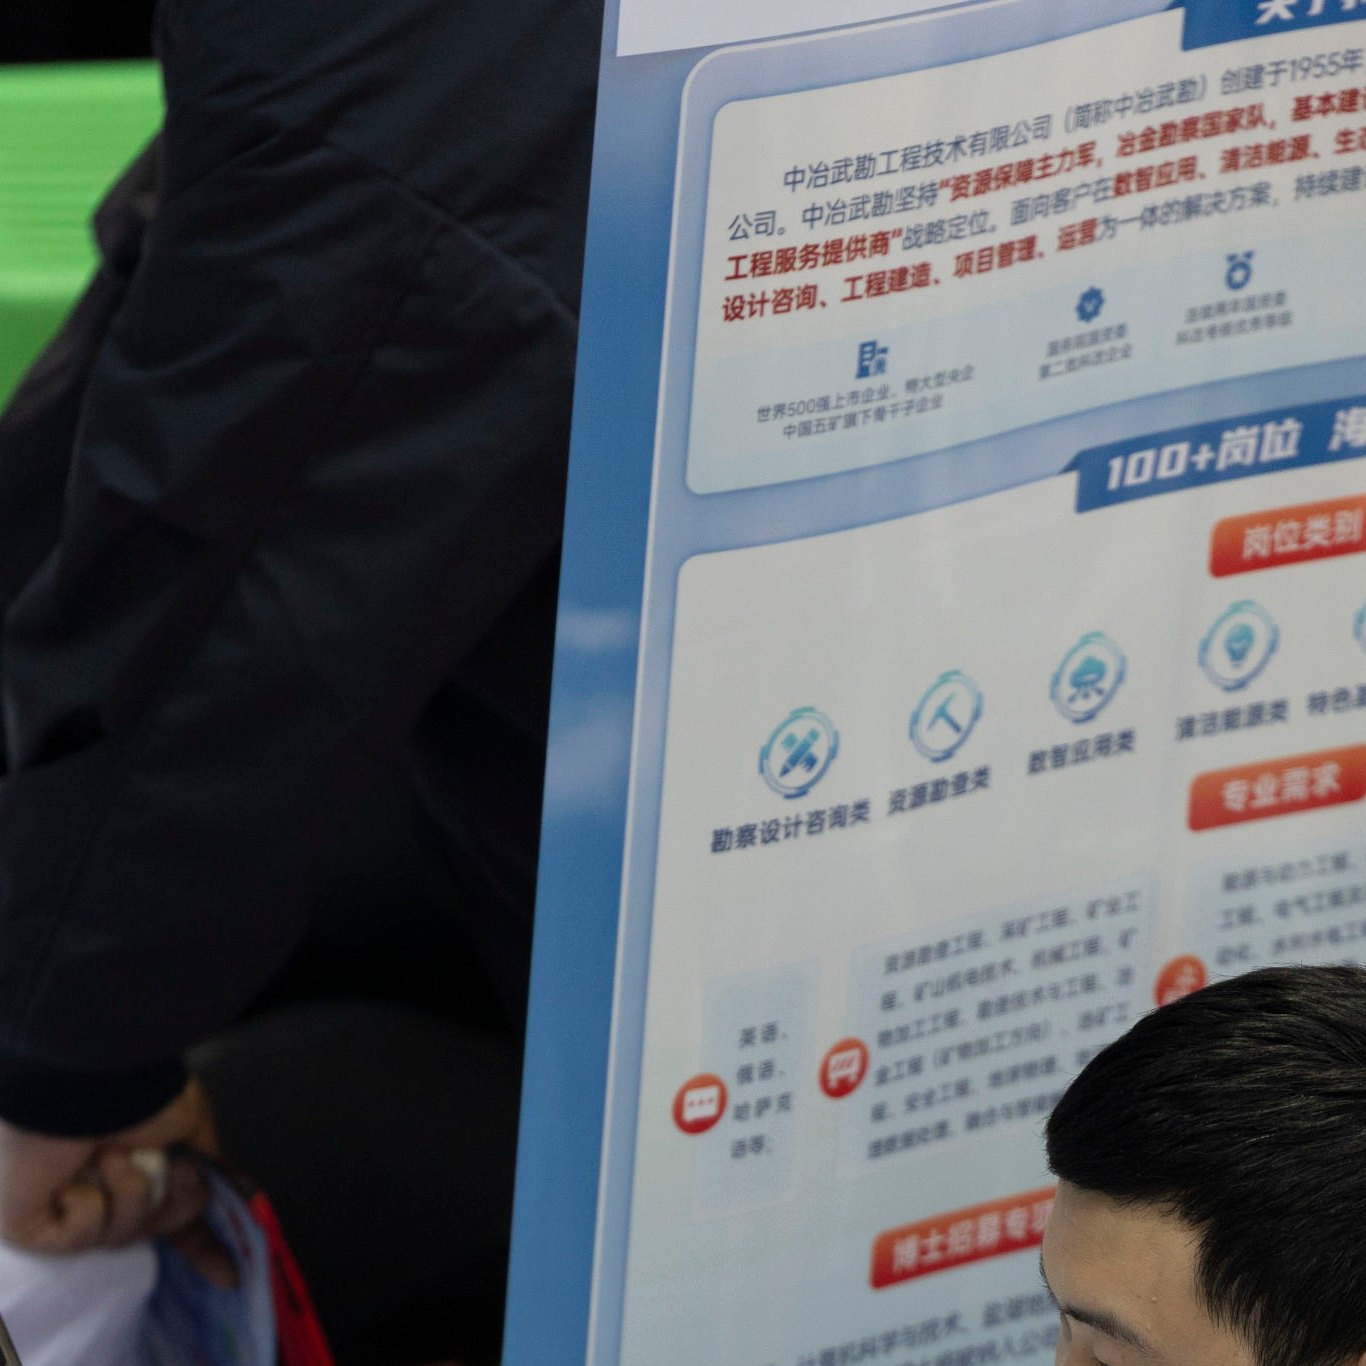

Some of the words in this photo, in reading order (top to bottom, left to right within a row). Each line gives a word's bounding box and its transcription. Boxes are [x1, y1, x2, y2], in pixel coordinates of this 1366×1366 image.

[1108, 417, 1302, 490] 100+岗位
[1241, 511, 1365, 561] 岗位类别
[1026, 728, 1136, 775] 数智应用类
[886, 766, 991, 816] 资源勘查类
[1221, 764, 1343, 813] 专业需求
[709, 799, 871, 853] 勘察设计咨询类
